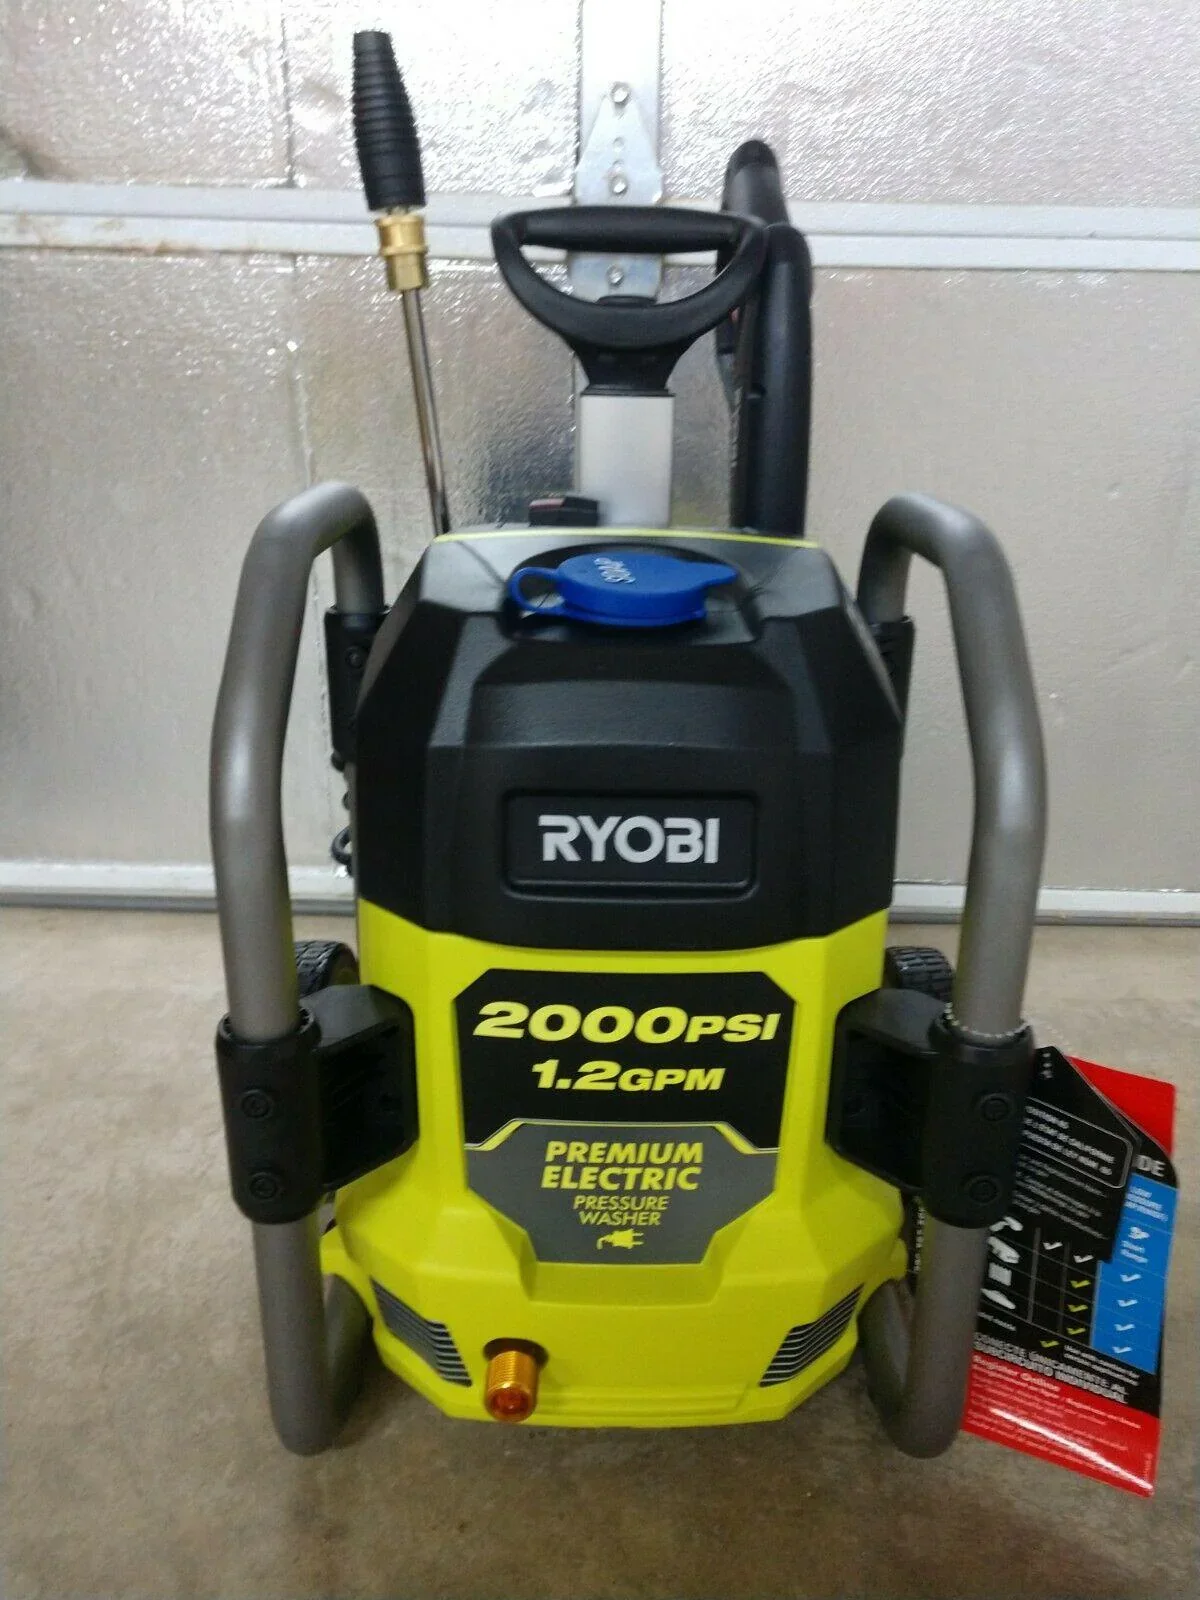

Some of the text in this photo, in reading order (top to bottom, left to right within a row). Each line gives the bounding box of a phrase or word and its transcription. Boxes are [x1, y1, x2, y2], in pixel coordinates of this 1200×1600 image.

[538, 814, 720, 864] RYOBI
[545, 1140, 704, 1165] PREMIUM
[541, 1166, 702, 1191] ELECTRIC
[573, 1195, 671, 1211] PRESSURE
[578, 1211, 661, 1226] WASHER
